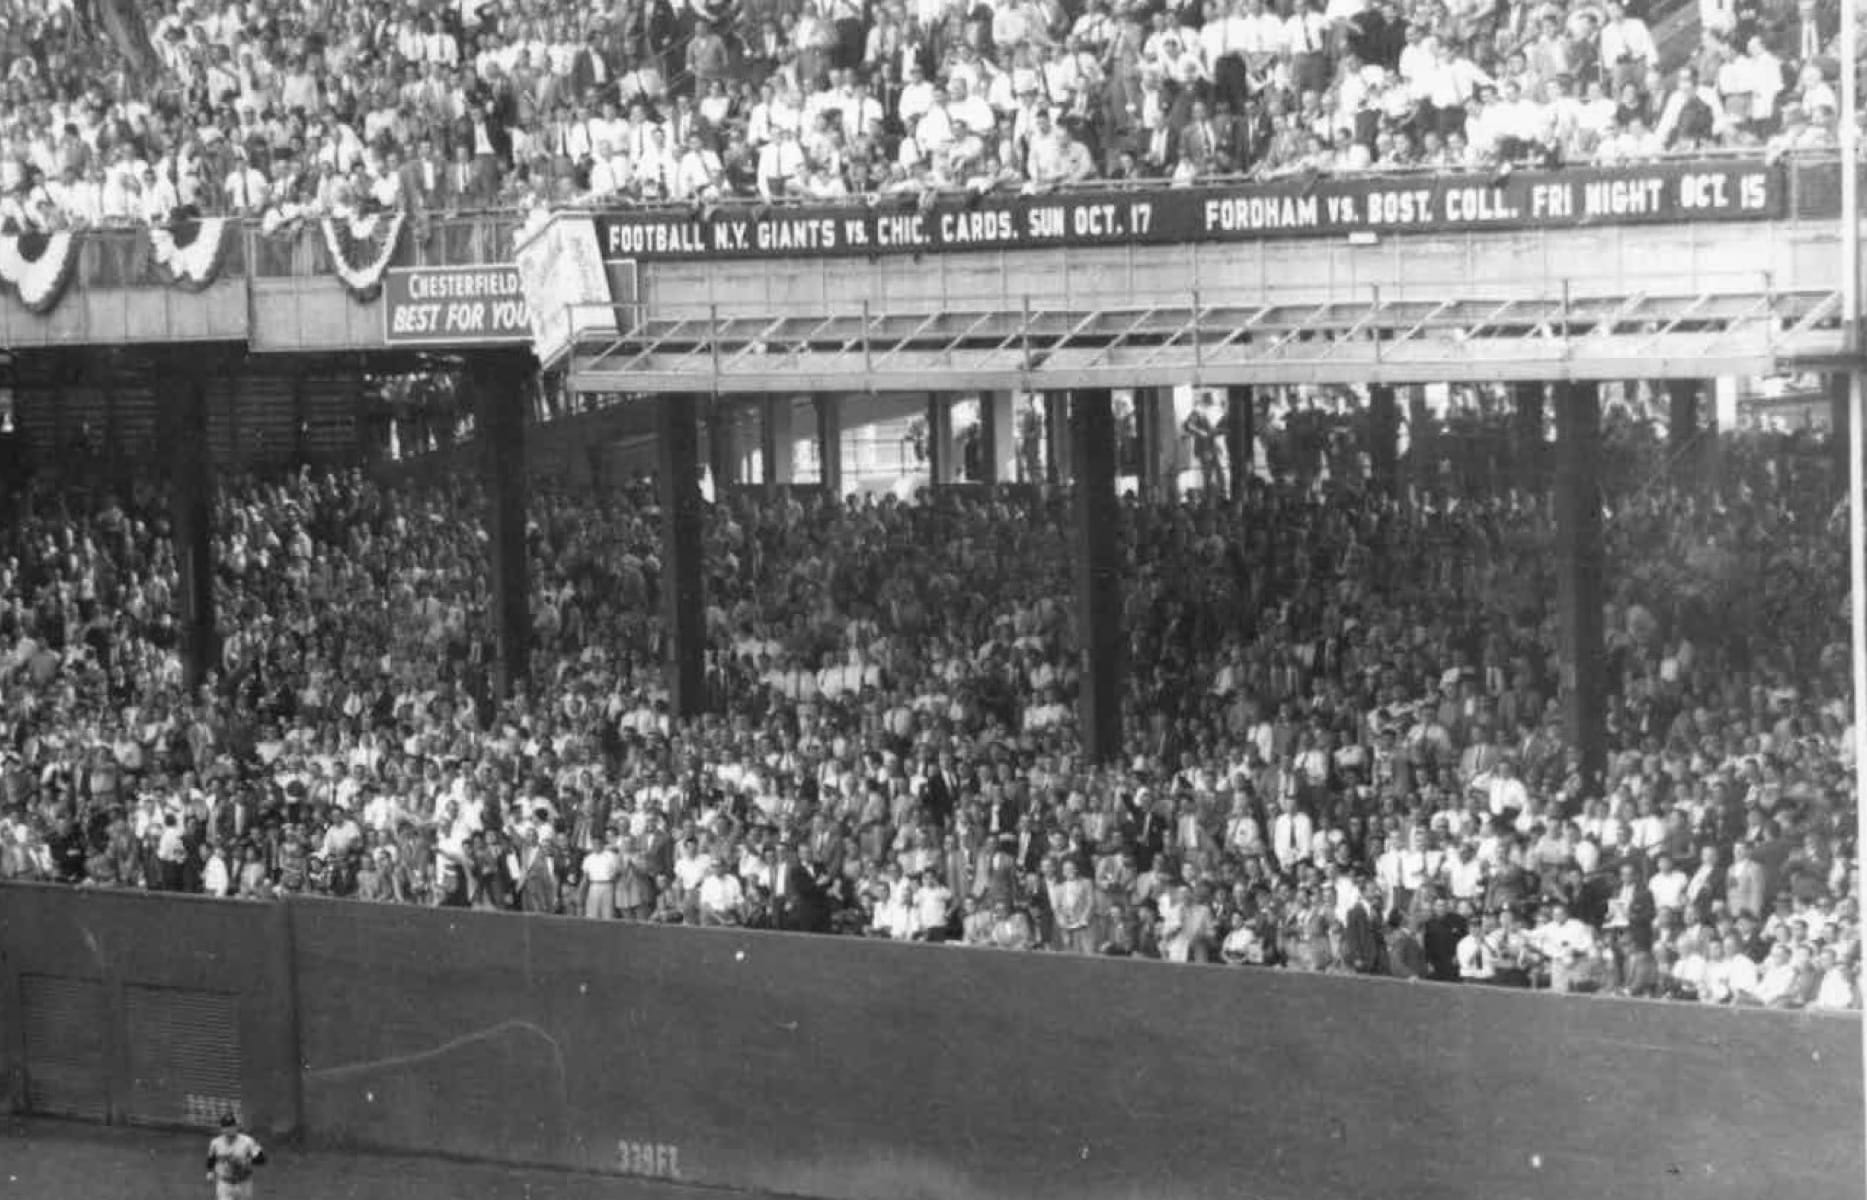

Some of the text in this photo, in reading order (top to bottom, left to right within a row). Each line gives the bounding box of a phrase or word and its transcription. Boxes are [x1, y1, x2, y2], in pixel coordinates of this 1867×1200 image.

[1205, 194, 1318, 231] FORDHAM
[1327, 196, 1358, 223] VS.
[1367, 190, 1433, 224] BOST.
[1446, 187, 1518, 220] COLL.
[1532, 184, 1573, 217] FRI
[1585, 179, 1662, 214] NIGHT
[1741, 173, 1766, 209] 15
[609, 204, 1151, 252] FOOTBALL N.Y. GIANTS VS. CHIC. CARDS. SUN OCT. 17
[393, 304, 441, 333] BEST
[445, 302, 485, 331] FOR
